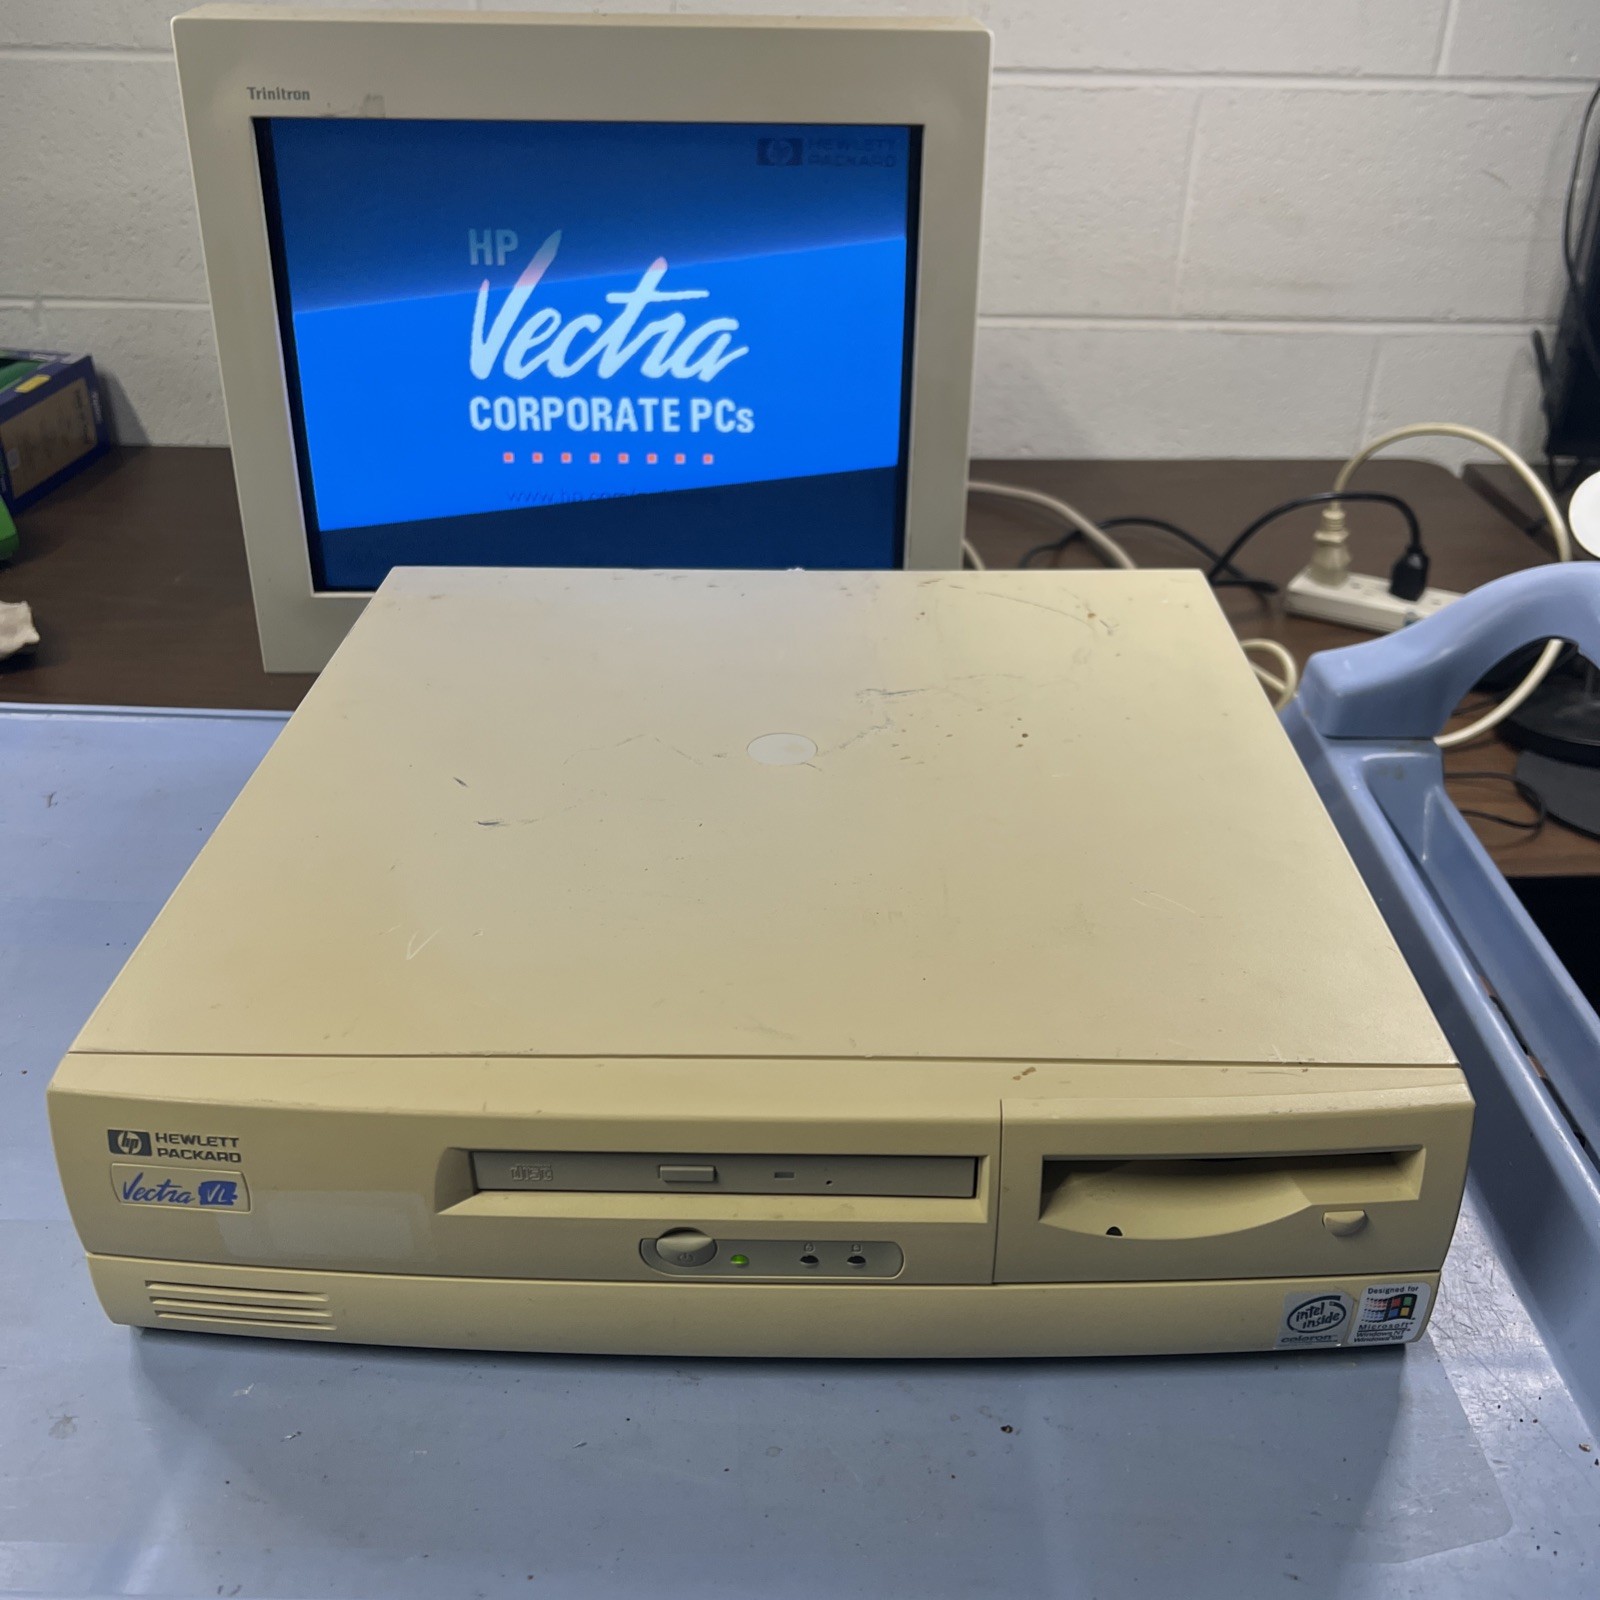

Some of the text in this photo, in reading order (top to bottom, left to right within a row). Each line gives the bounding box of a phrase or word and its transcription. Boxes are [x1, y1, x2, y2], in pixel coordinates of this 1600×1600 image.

[246, 86, 311, 101] Trinitron
[467, 228, 518, 266] HP
[470, 229, 749, 382] Vectra
[468, 396, 755, 433] CORPORATE PCs
[155, 1132, 239, 1148] HEWLETT
[157, 1148, 242, 1163] PACKARD
[123, 1172, 195, 1204] Vectra
[1367, 1286, 1405, 1295] Designed
[1295, 1301, 1326, 1322] intel
[1302, 1311, 1341, 1329] inside
[1358, 1321, 1409, 1331] Microsoft
